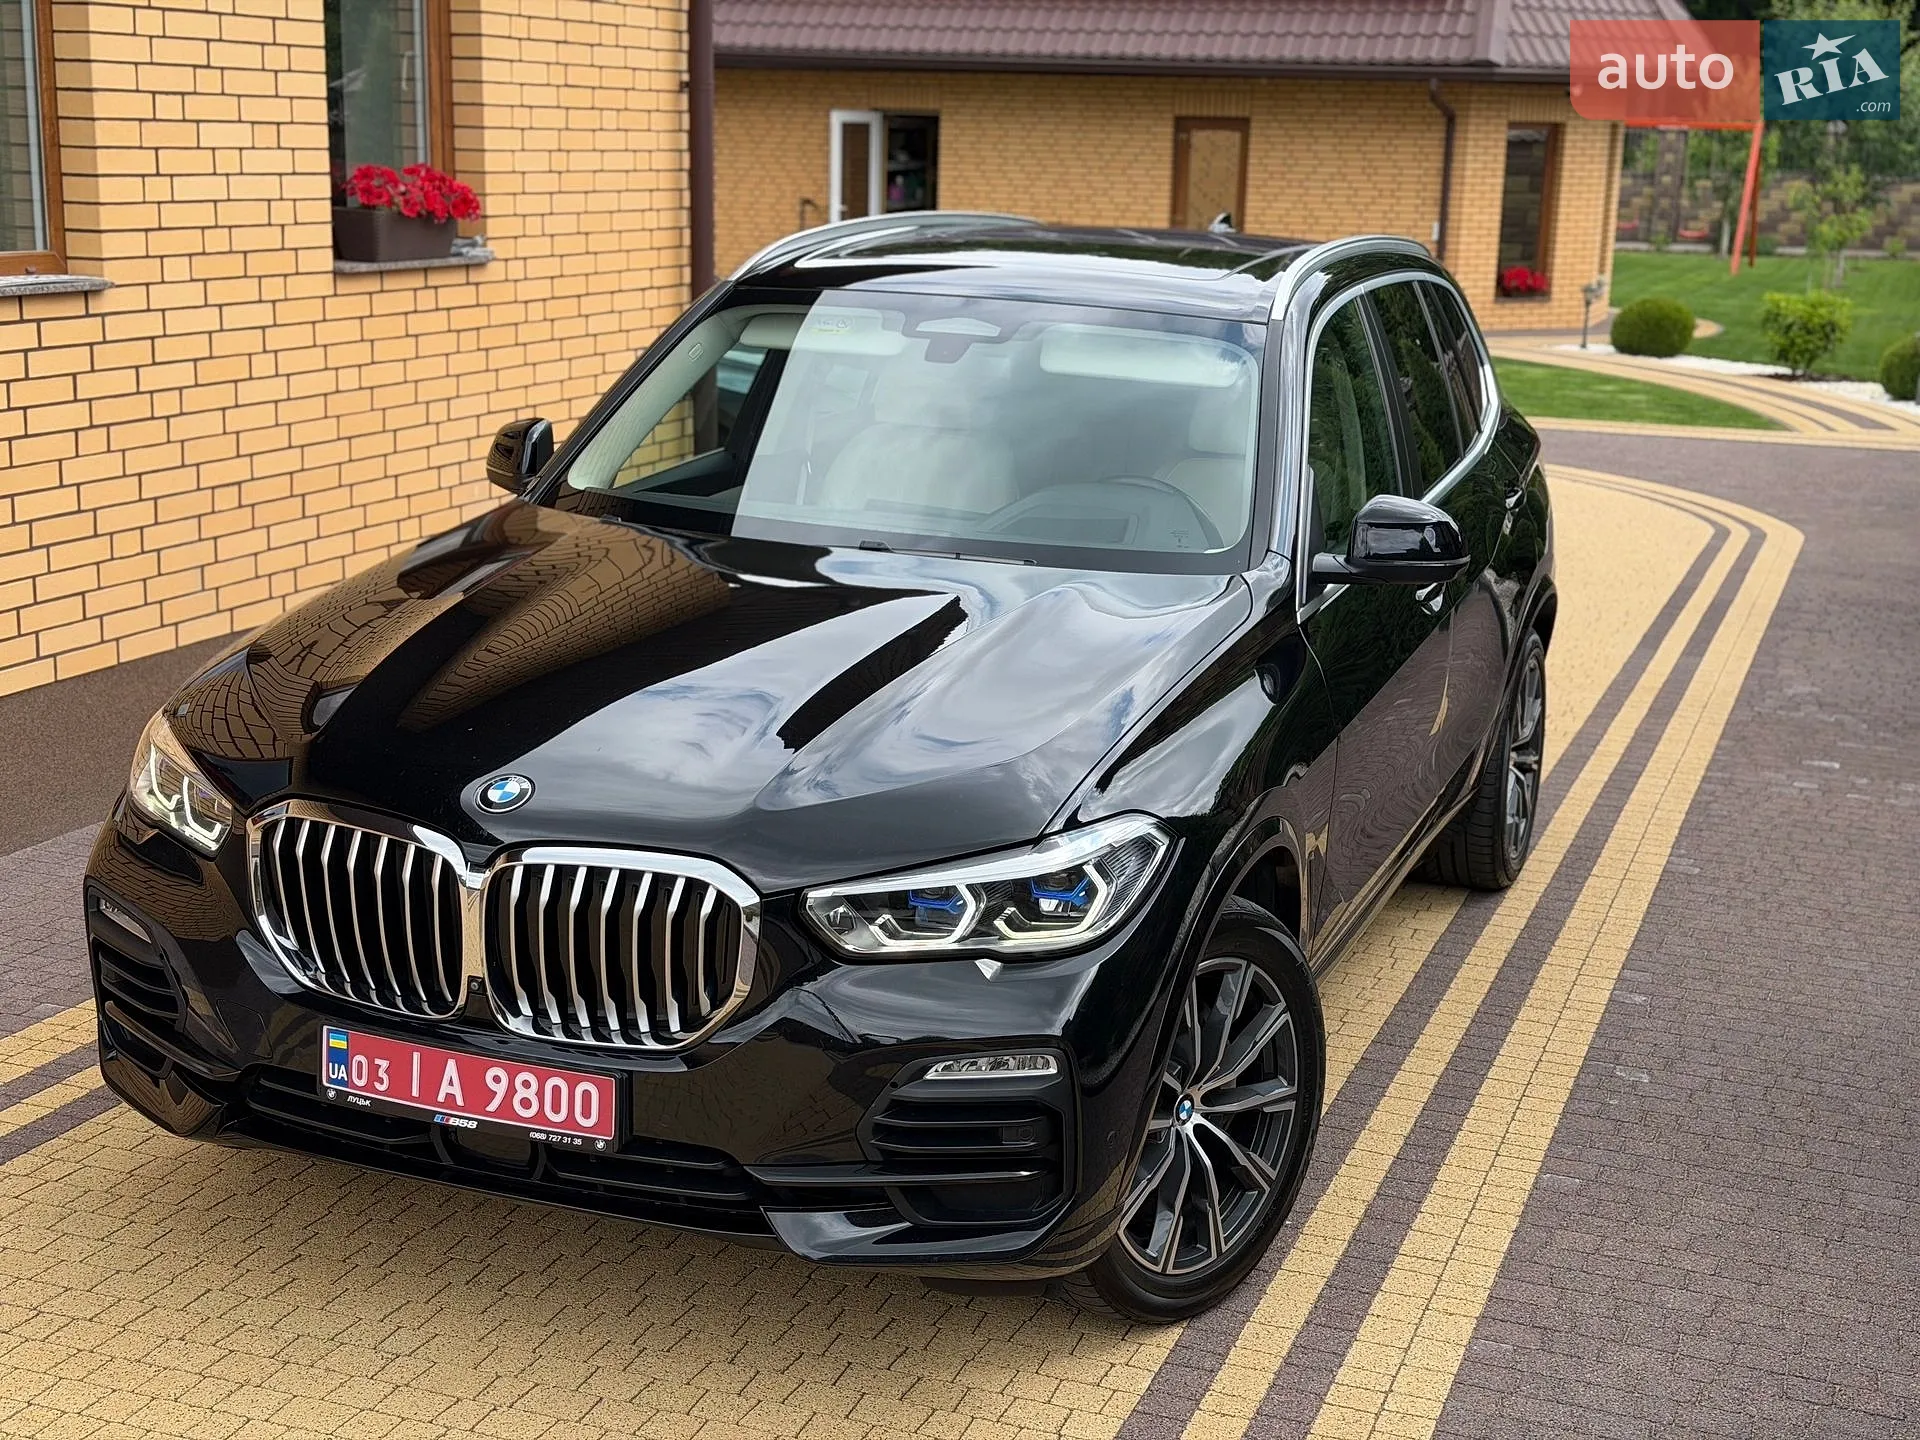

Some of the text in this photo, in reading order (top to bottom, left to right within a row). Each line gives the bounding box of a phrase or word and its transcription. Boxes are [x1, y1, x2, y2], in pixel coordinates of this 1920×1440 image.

[328, 1062, 348, 1081] UA
[352, 1054, 390, 1092] 03
[485, 1066, 600, 1128] 9800
[548, 1134, 561, 1142] 727
[562, 1136, 571, 1144] 31
